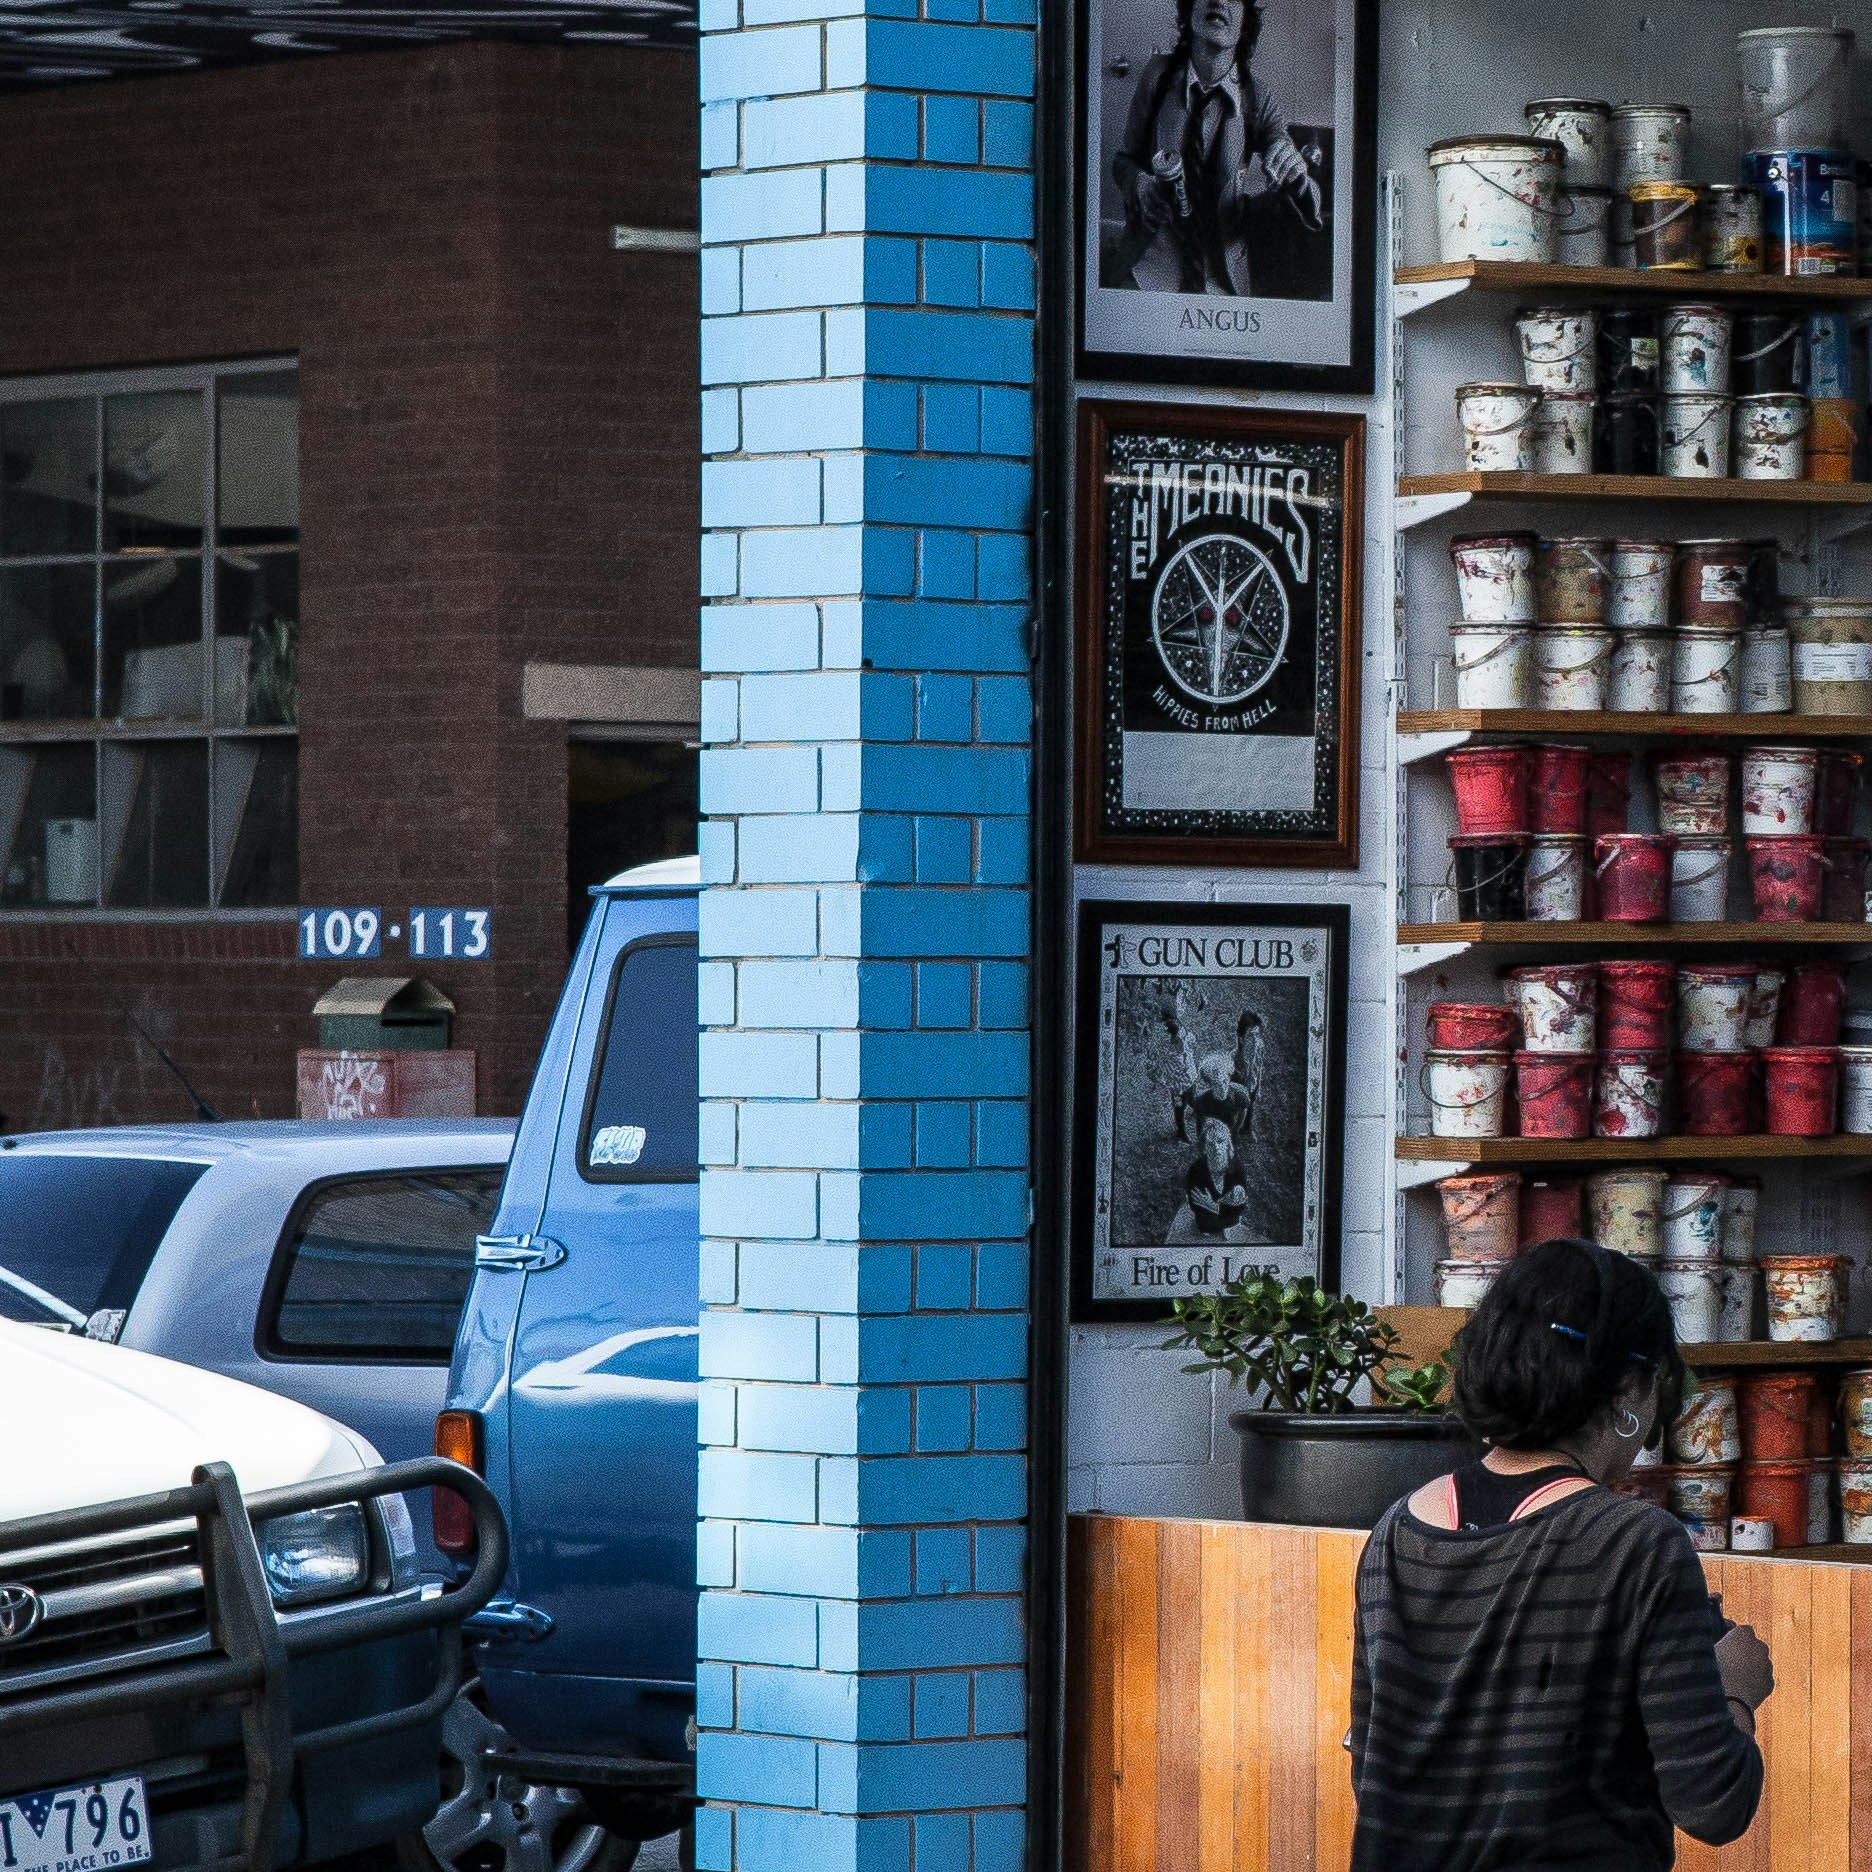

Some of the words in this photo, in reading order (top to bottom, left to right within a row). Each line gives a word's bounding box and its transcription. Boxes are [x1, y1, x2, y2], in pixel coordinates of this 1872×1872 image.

[1179, 308, 1261, 333] ANGUS
[1131, 462, 1149, 580] THE
[1149, 462, 1310, 584] MEANIES
[1152, 684, 1200, 729] HIPPIES
[1205, 715, 1239, 731] FROM
[1241, 699, 1277, 729] HELL
[302, 910, 378, 955] 109
[411, 911, 488, 957] 113
[1138, 936, 1206, 967] GUN
[1215, 938, 1294, 969] CLUB
[1132, 1256, 1180, 1286] Fire
[1187, 1255, 1213, 1286] of
[55, 1788, 140, 1855] 796
[102, 1850, 120, 1864] TO
[126, 1845, 142, 1860] BE
